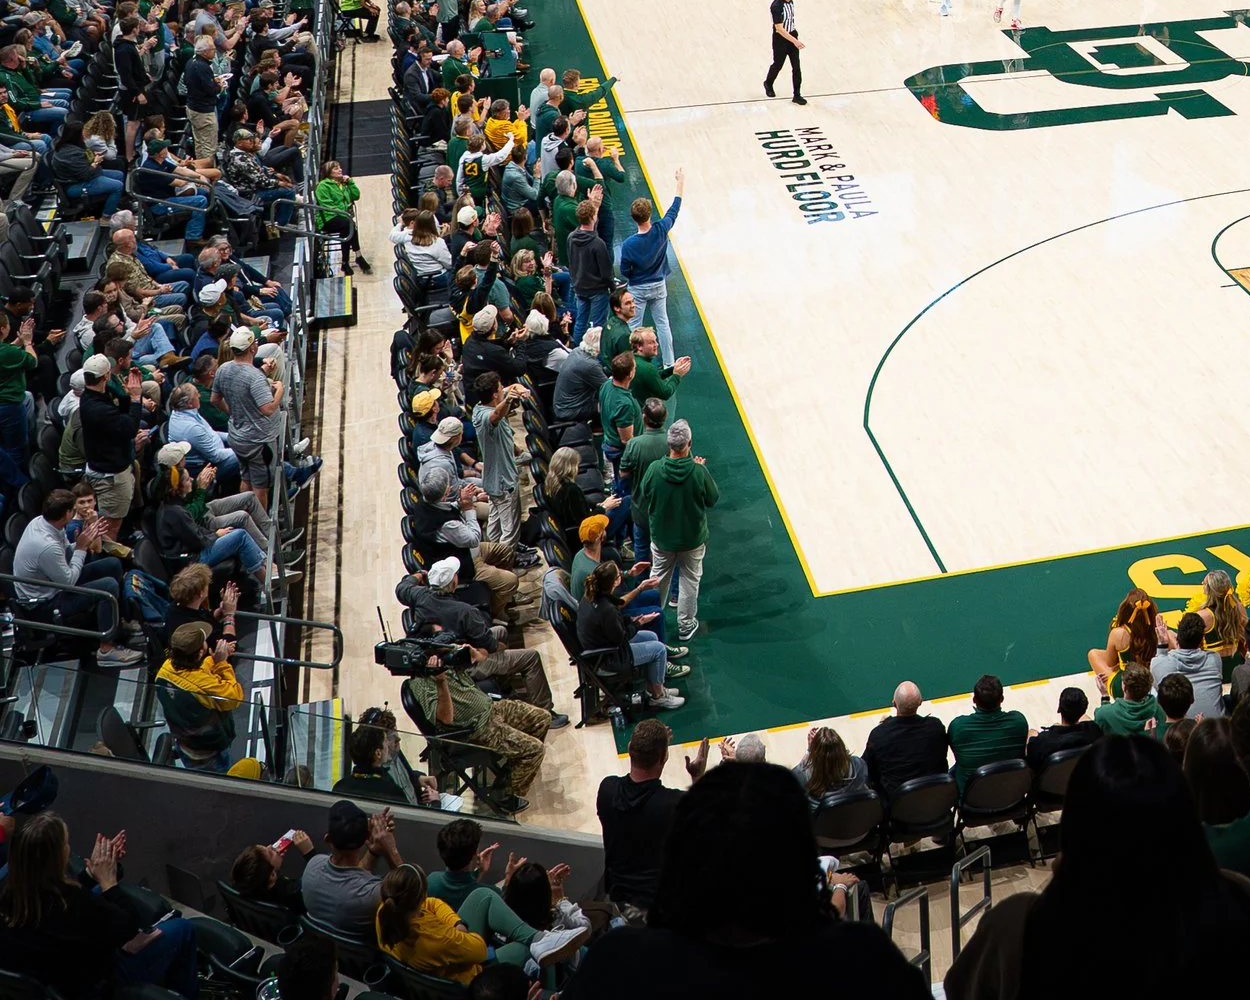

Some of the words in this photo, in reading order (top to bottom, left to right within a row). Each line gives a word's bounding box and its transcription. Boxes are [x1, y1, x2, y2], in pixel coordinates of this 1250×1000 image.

[754, 129, 811, 170] HURD
[795, 126, 841, 161] MARK
[465, 162, 478, 177] 23
[819, 163, 846, 172] &
[780, 171, 846, 225] FLOOR
[826, 175, 879, 219] PAULA
